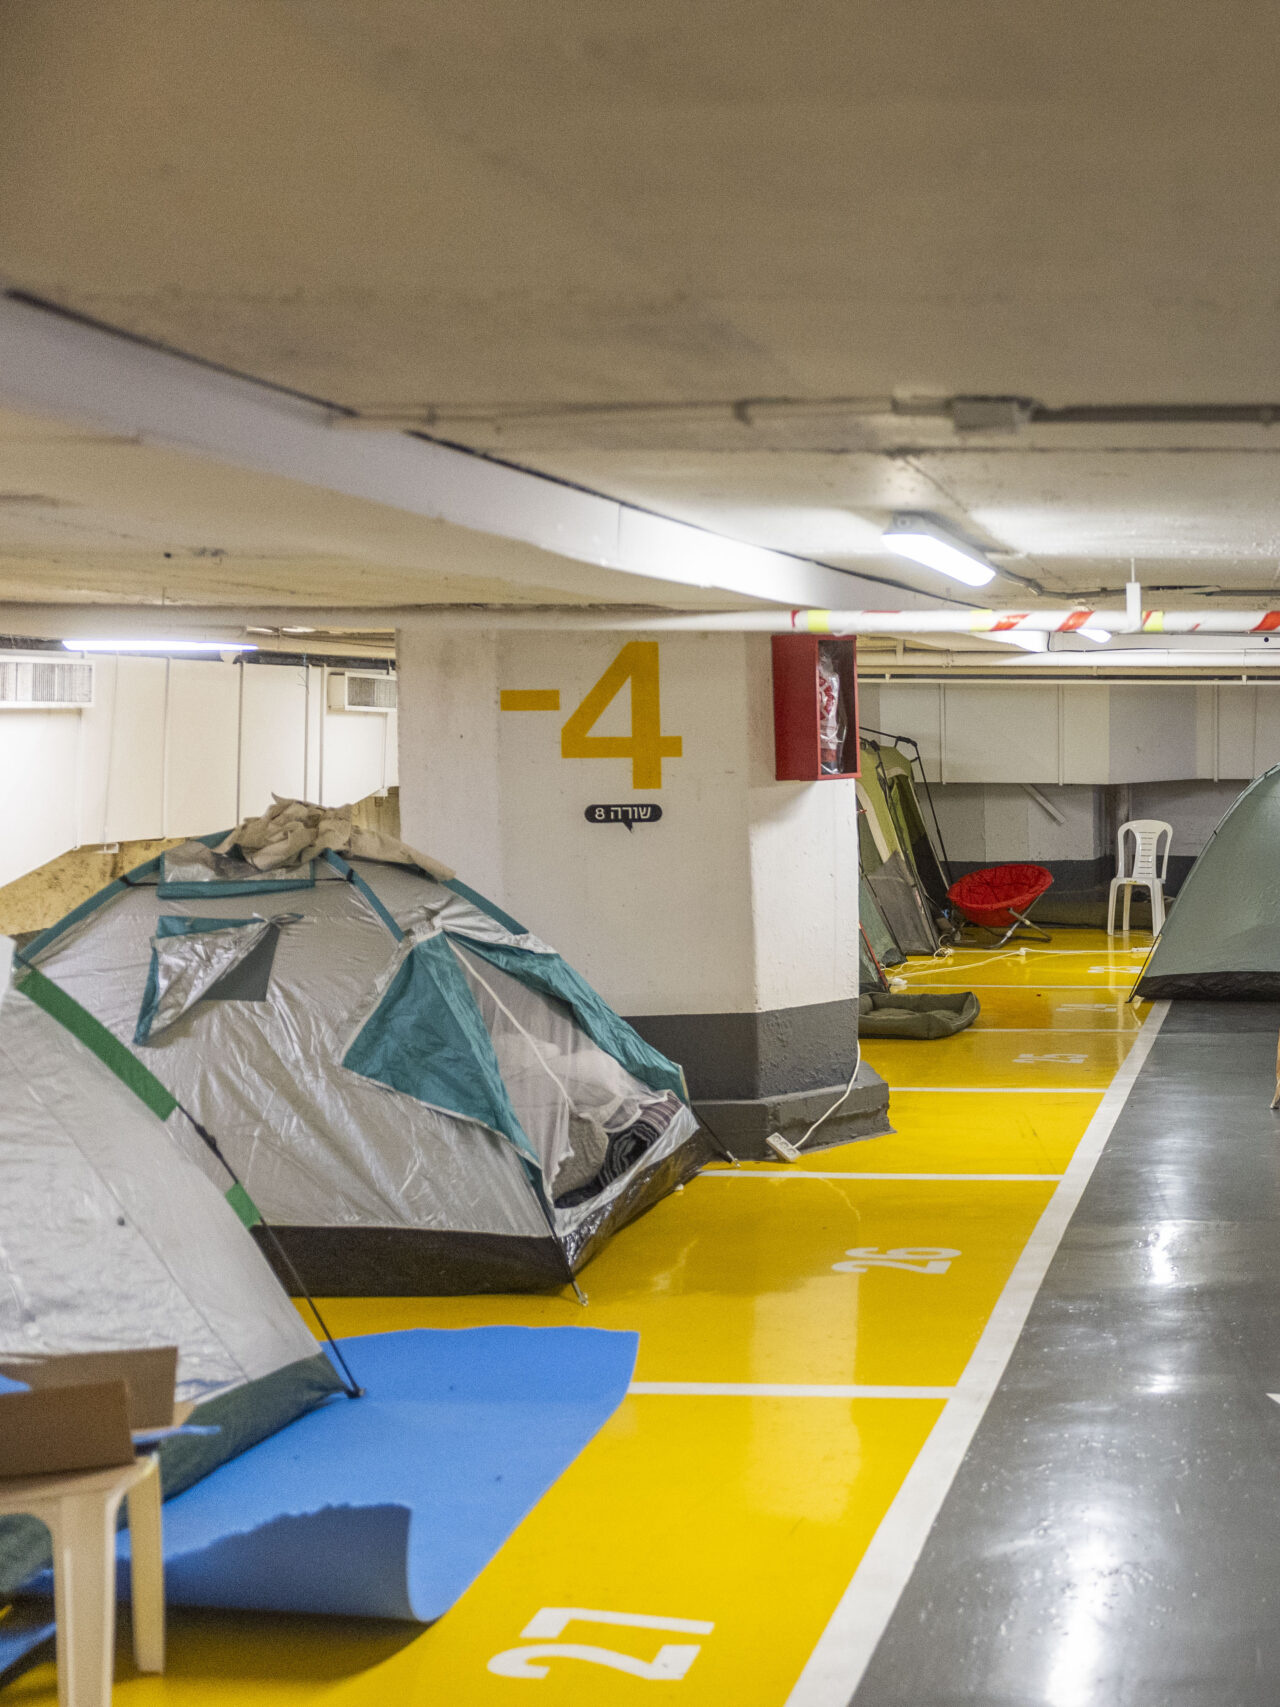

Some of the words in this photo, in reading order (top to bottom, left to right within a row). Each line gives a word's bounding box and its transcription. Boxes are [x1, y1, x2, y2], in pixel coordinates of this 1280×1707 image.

[500, 641, 683, 790] -4
[594, 807, 606, 820] 8
[610, 806, 652, 820] שורה
[1012, 1053, 1089, 1064] 25
[831, 1246, 963, 1275] 26
[486, 1606, 716, 1681] 27
